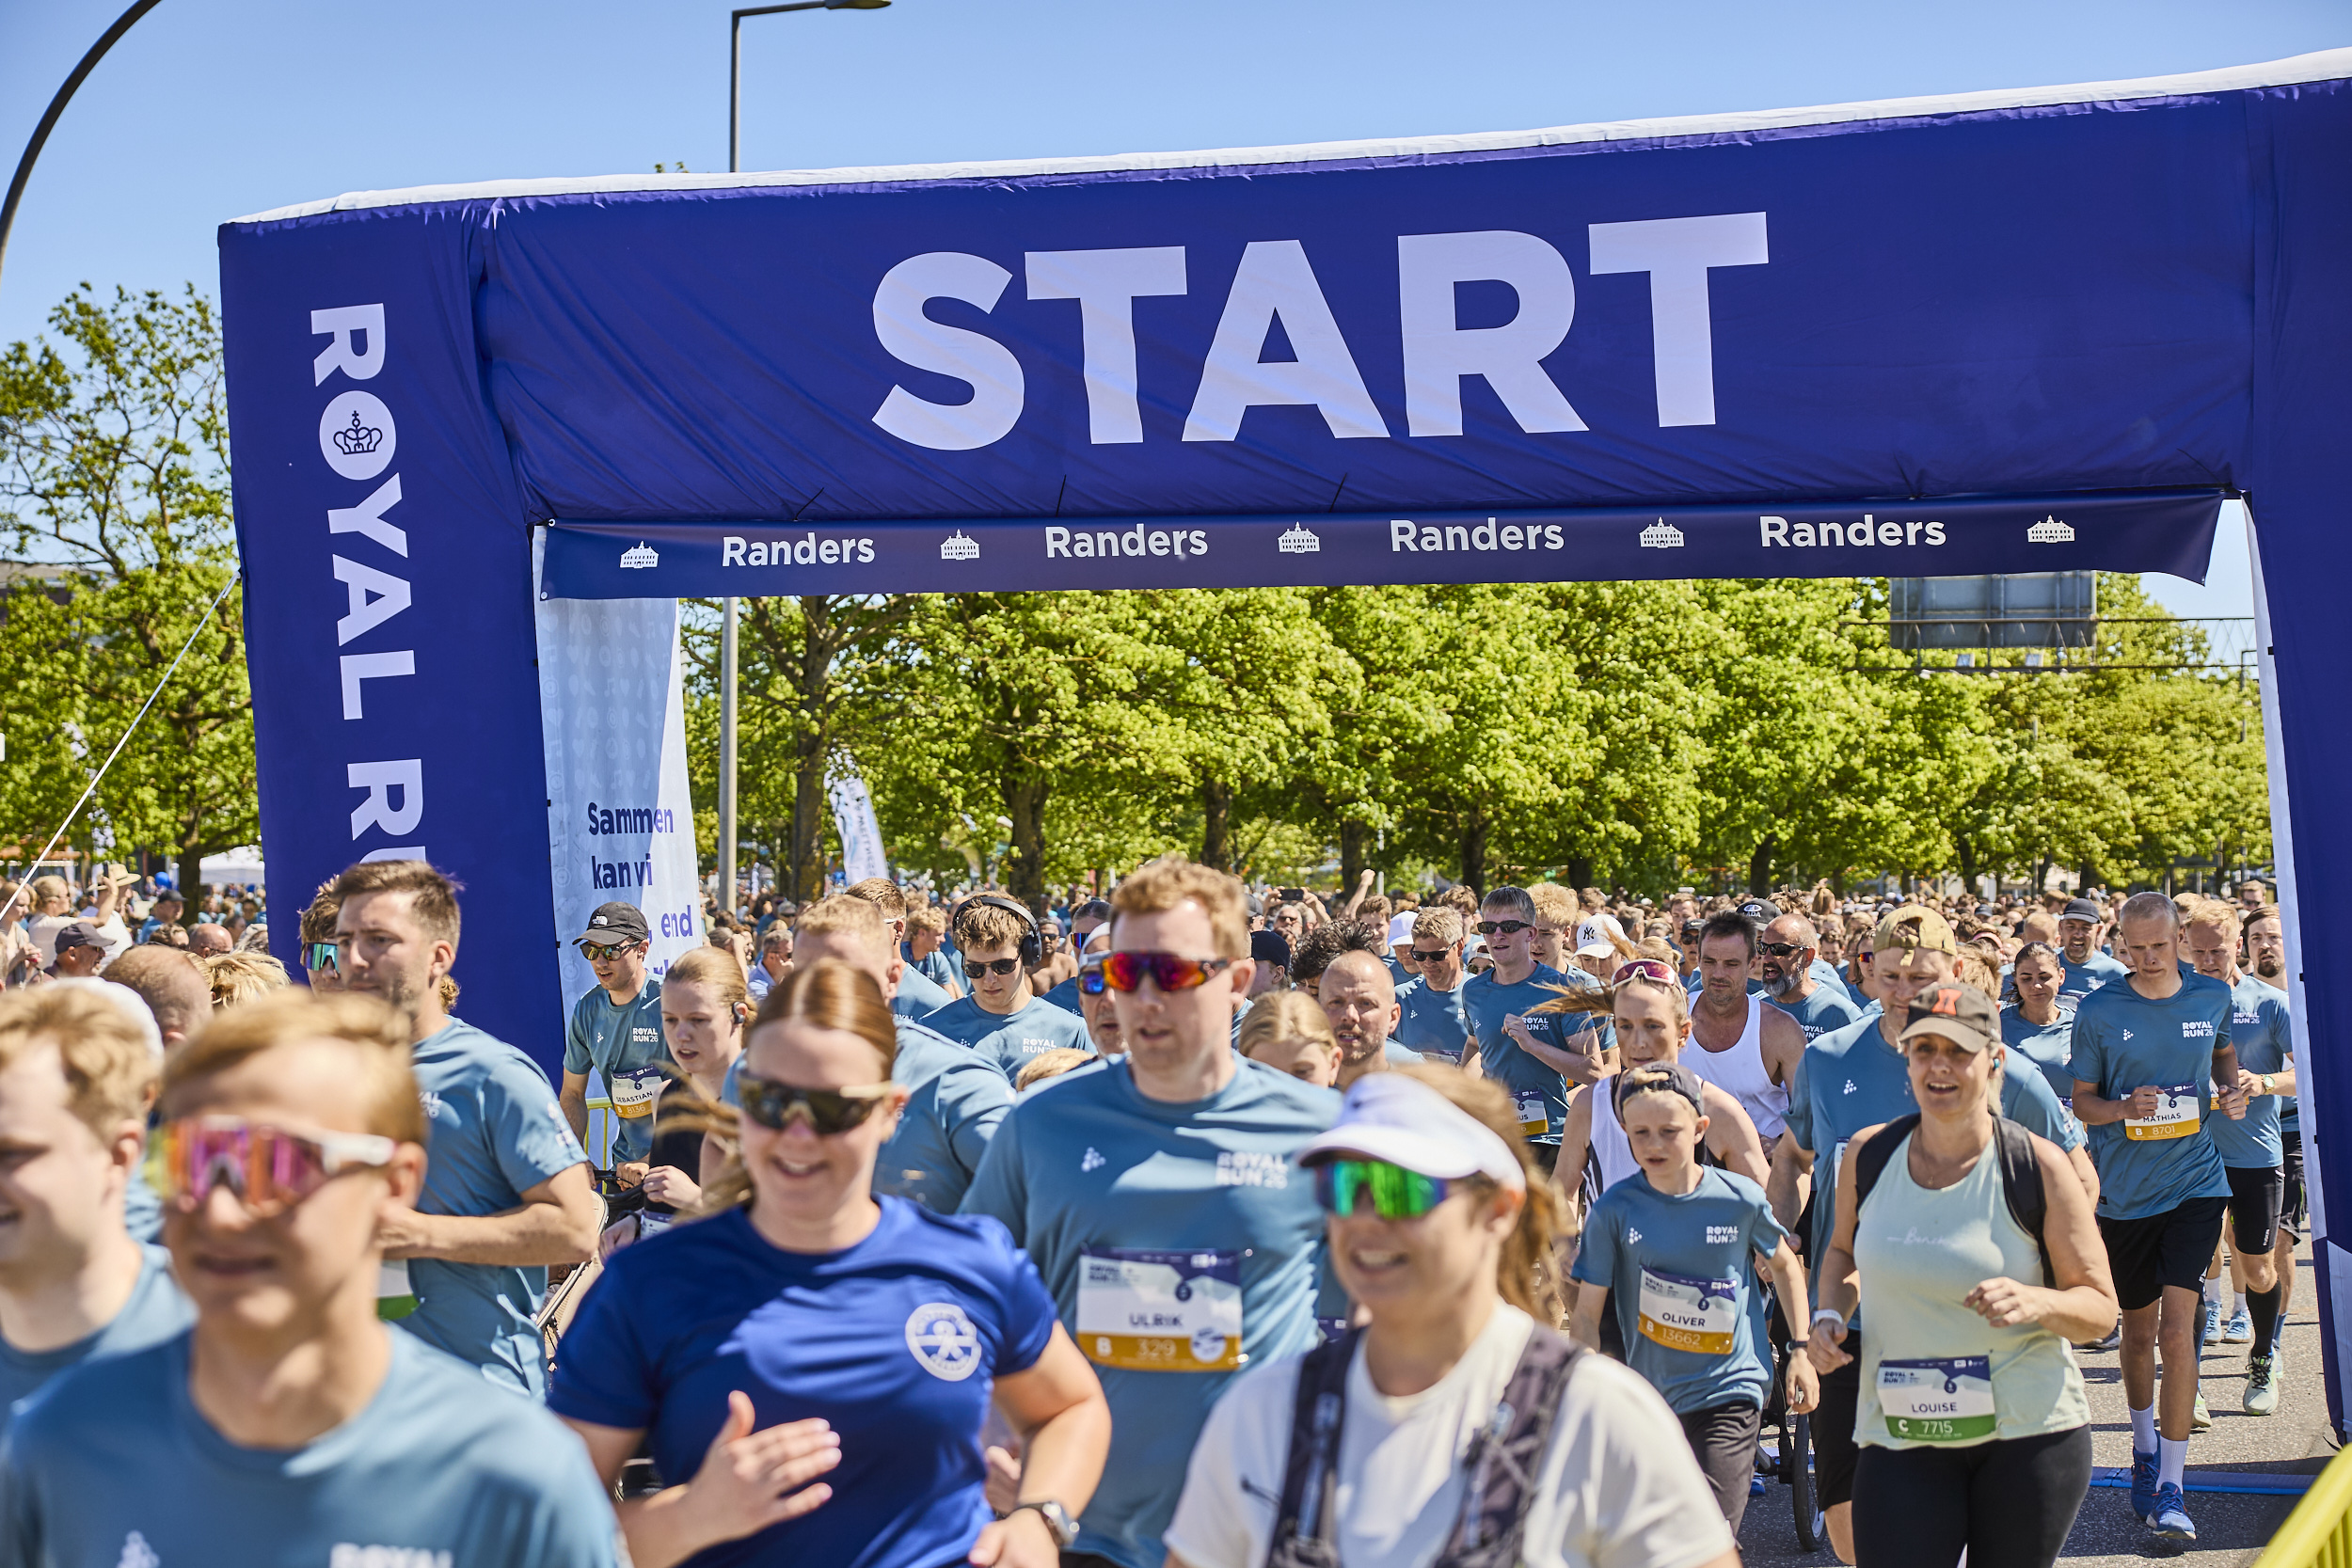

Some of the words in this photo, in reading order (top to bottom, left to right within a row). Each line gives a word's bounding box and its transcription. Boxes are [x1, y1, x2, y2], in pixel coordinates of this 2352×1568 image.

[871, 212, 1769, 451] START
[310, 302, 416, 721] ROYAL
[1046, 522, 1208, 558] Randers
[1390, 516, 1565, 553] Randers
[1759, 514, 1947, 548] Randers
[723, 531, 875, 567] Randers
[588, 802, 674, 835] Sammen
[591, 855, 632, 890] kan
[634, 853, 653, 886] vi
[661, 905, 693, 938] end
[632, 1027, 659, 1036] ROYAL
[2182, 1021, 2213, 1031] ROYAL
[1023, 1037, 1057, 1049] ROYAL
[627, 1103, 646, 1115] 8136
[2142, 1112, 2183, 1123] MATHIAS
[2135, 1128, 2143, 1136] B
[2152, 1125, 2176, 1136] 8701
[1706, 1226, 1739, 1235] ROYAL
[1129, 1313, 1183, 1327] ULRIK
[1661, 1312, 1706, 1327] OLIVER
[1645, 1320, 1655, 1333] B
[1661, 1327, 1701, 1346] 13662
[1096, 1336, 1112, 1357] B
[1136, 1338, 1177, 1357] 329
[1911, 1402, 1958, 1414] LOUISE
[1898, 1418, 1909, 1433] C
[1920, 1419, 1953, 1435] 7715
